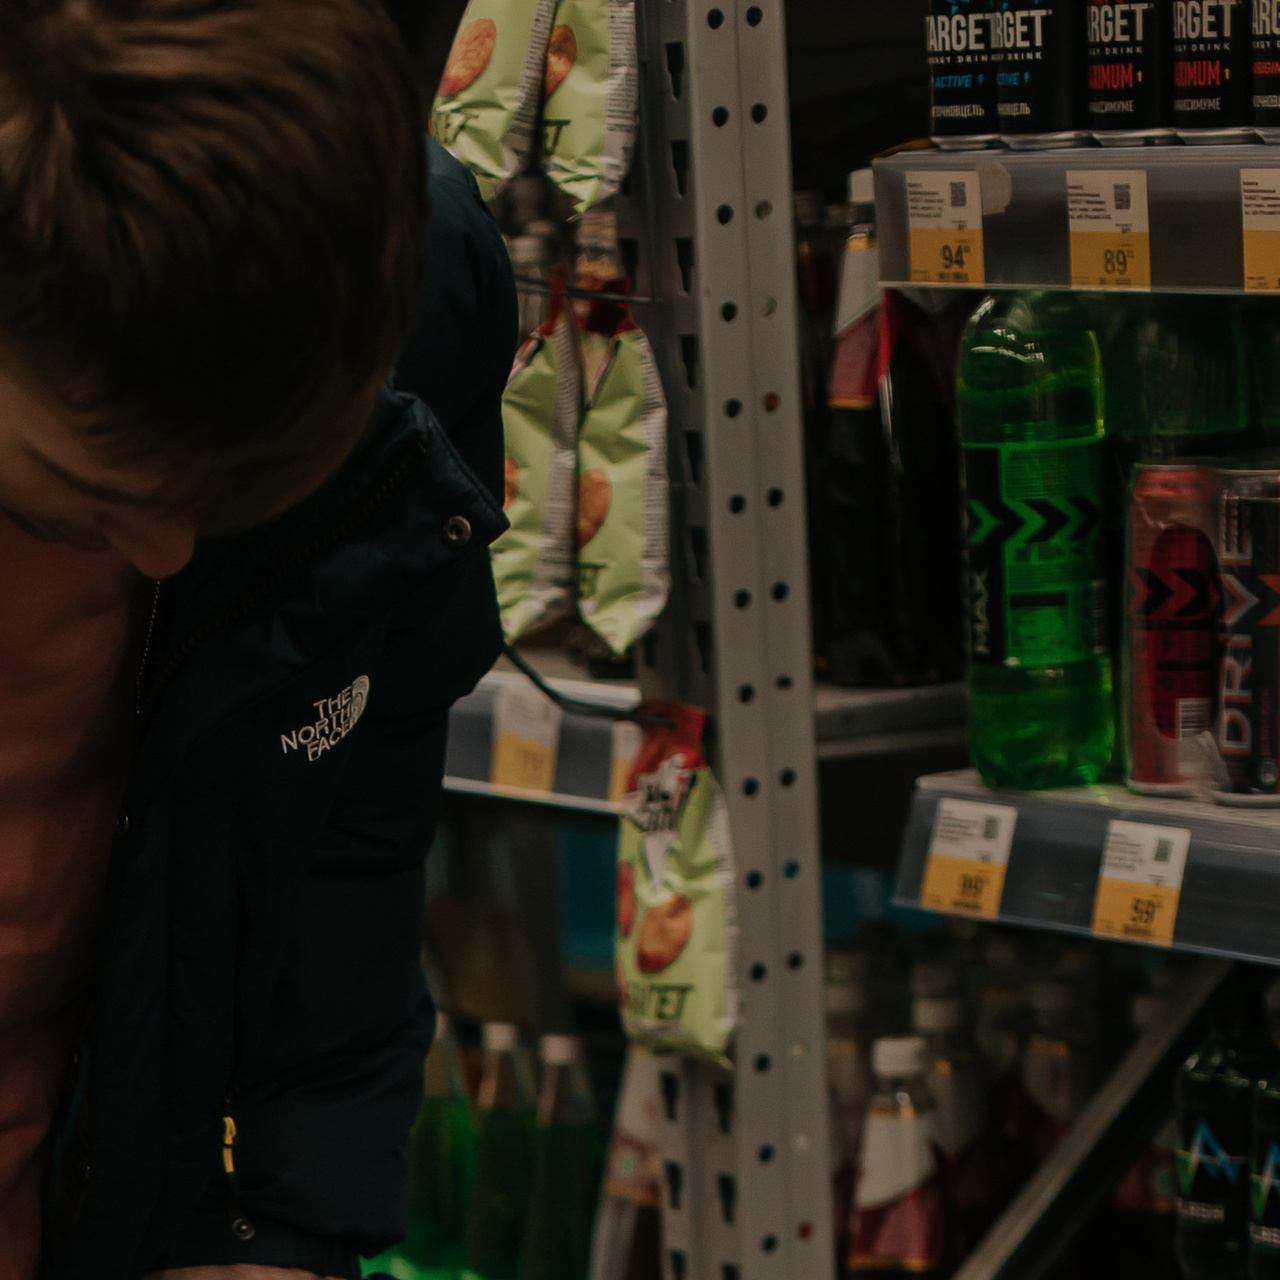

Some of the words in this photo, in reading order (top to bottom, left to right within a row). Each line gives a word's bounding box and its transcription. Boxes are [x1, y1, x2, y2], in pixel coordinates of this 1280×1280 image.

[925, 13, 991, 51] ARGE
[991, 9, 1047, 48] RGET
[1104, 46, 1142, 55] DRINK
[1191, 42, 1230, 52] DRINK
[942, 244, 965, 270] 94
[1104, 249, 1127, 275] 89
[313, 685, 352, 720] THE
[280, 706, 352, 754] NORTH
[307, 722, 350, 762] FACE
